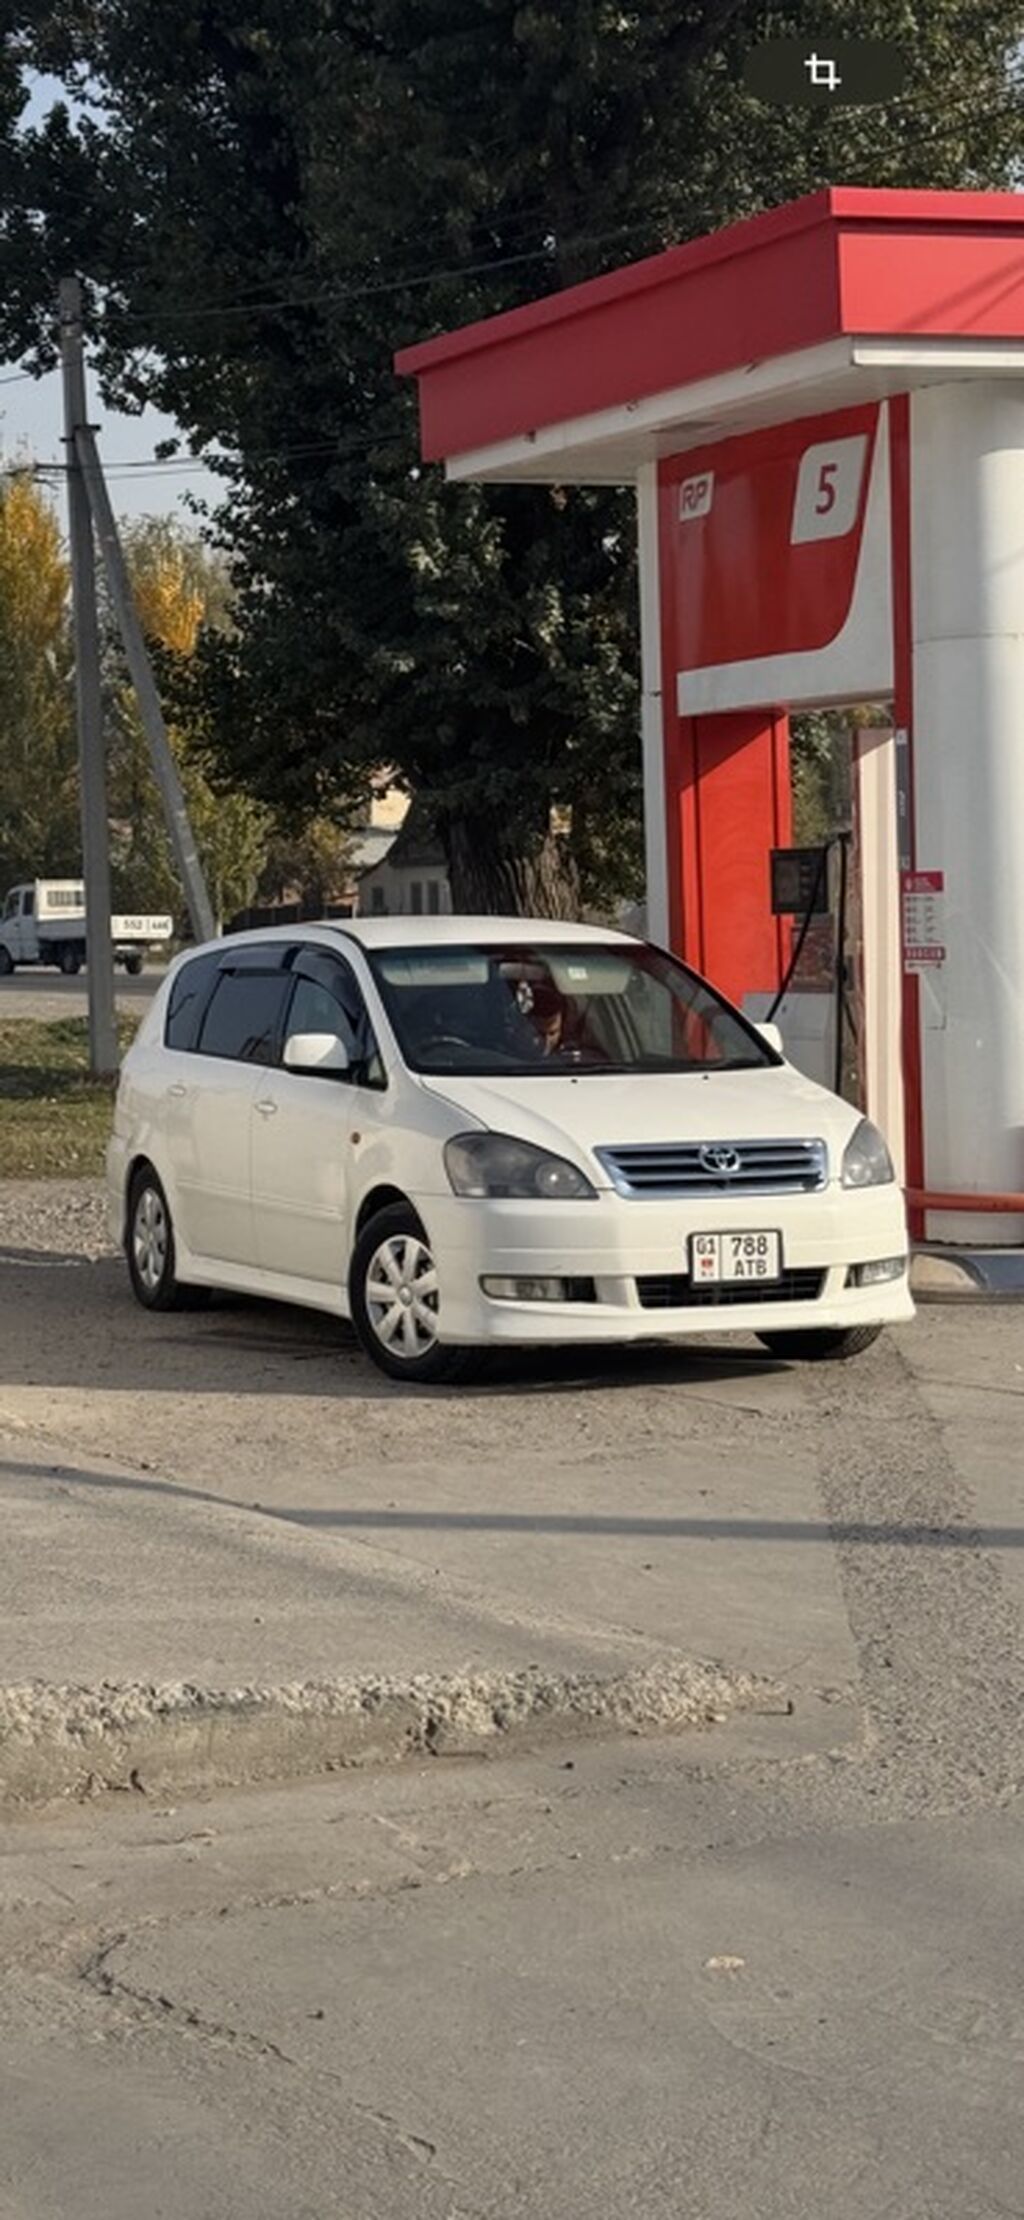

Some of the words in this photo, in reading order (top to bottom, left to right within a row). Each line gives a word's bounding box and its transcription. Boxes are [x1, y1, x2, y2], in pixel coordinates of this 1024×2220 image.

[815, 463, 838, 515] 5
[696, 1237, 716, 1255] 01
[731, 1235, 769, 1257] 788
[734, 1259, 768, 1277] ATB
